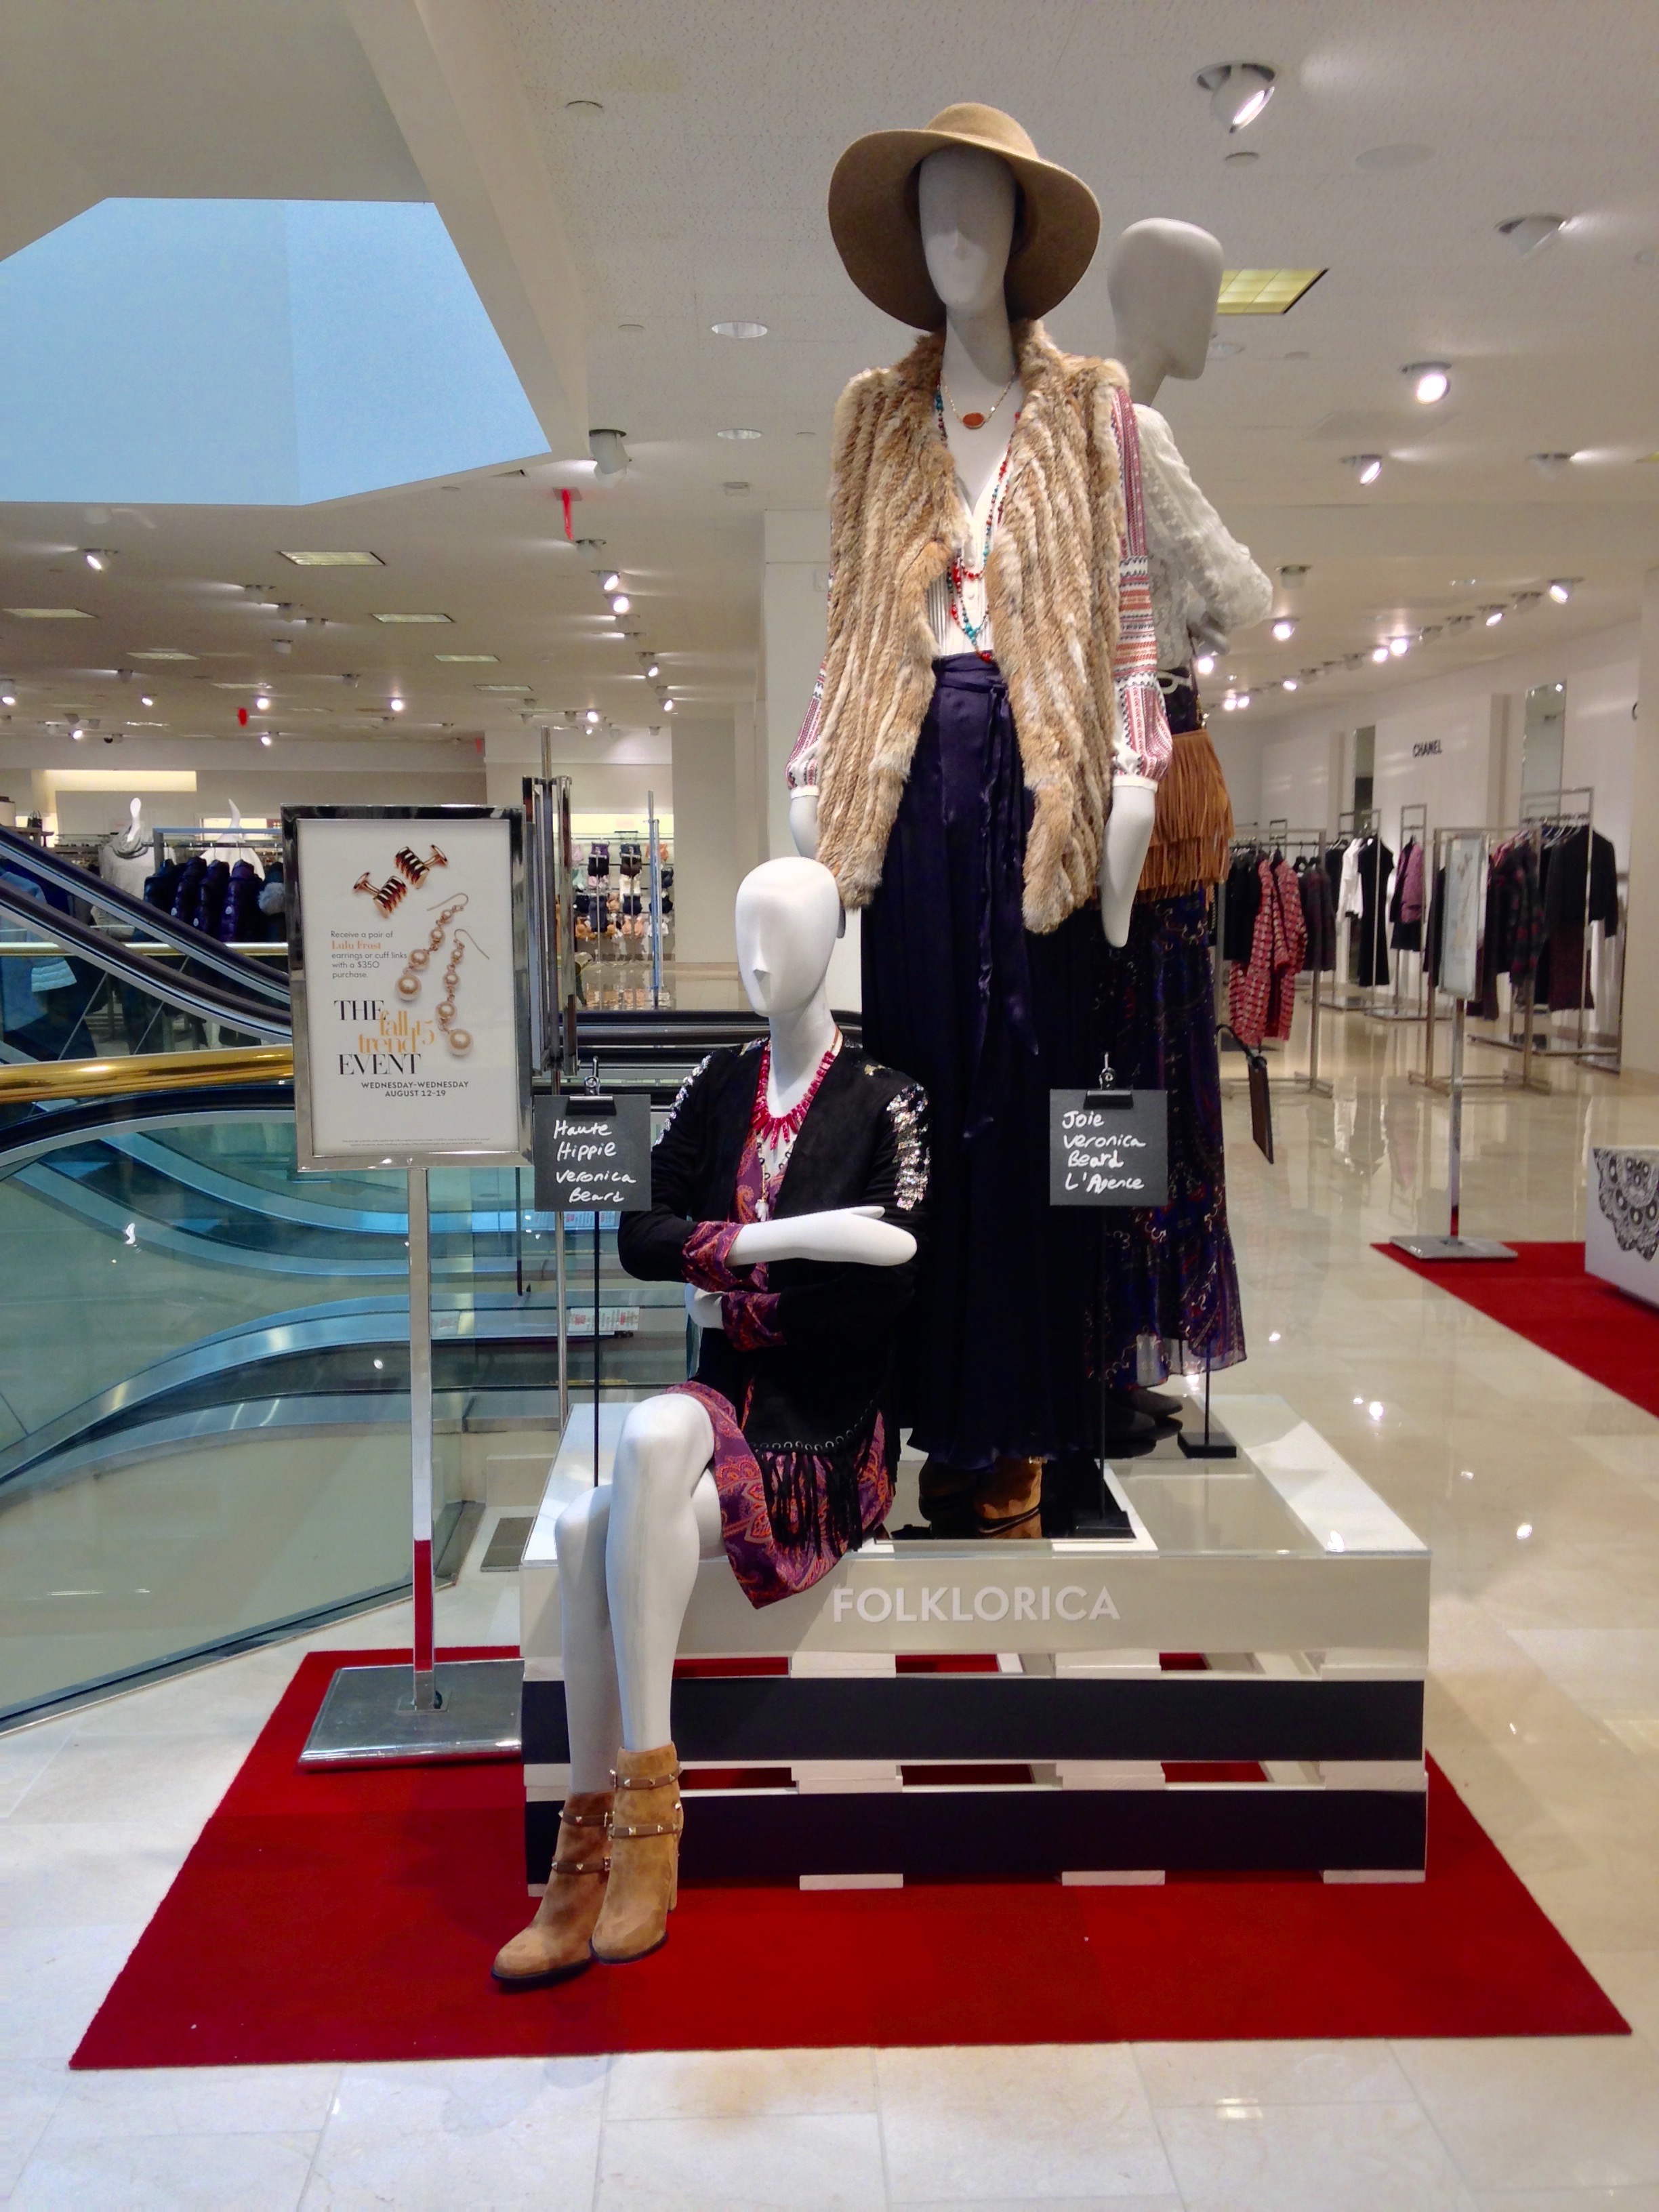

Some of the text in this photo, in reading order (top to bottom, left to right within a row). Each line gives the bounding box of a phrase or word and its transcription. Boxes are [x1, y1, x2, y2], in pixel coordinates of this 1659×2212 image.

[1412, 739, 1442, 757] CHANEL
[369, 931, 382, 939] pair
[331, 941, 381, 949] Lulu Frost
[357, 960, 380, 968] $350
[333, 1000, 386, 1021] THE
[380, 1010, 408, 1036] fall
[359, 1027, 416, 1052] trend
[337, 1054, 422, 1075] EVENT
[1062, 1110, 1105, 1129] Joie
[553, 1120, 612, 1140] Haute
[556, 1141, 617, 1162] Hippie
[1067, 1149, 1124, 1168] Beard
[569, 1187, 624, 1203] Beard
[833, 1585, 1122, 1623] FOLKLORICA
